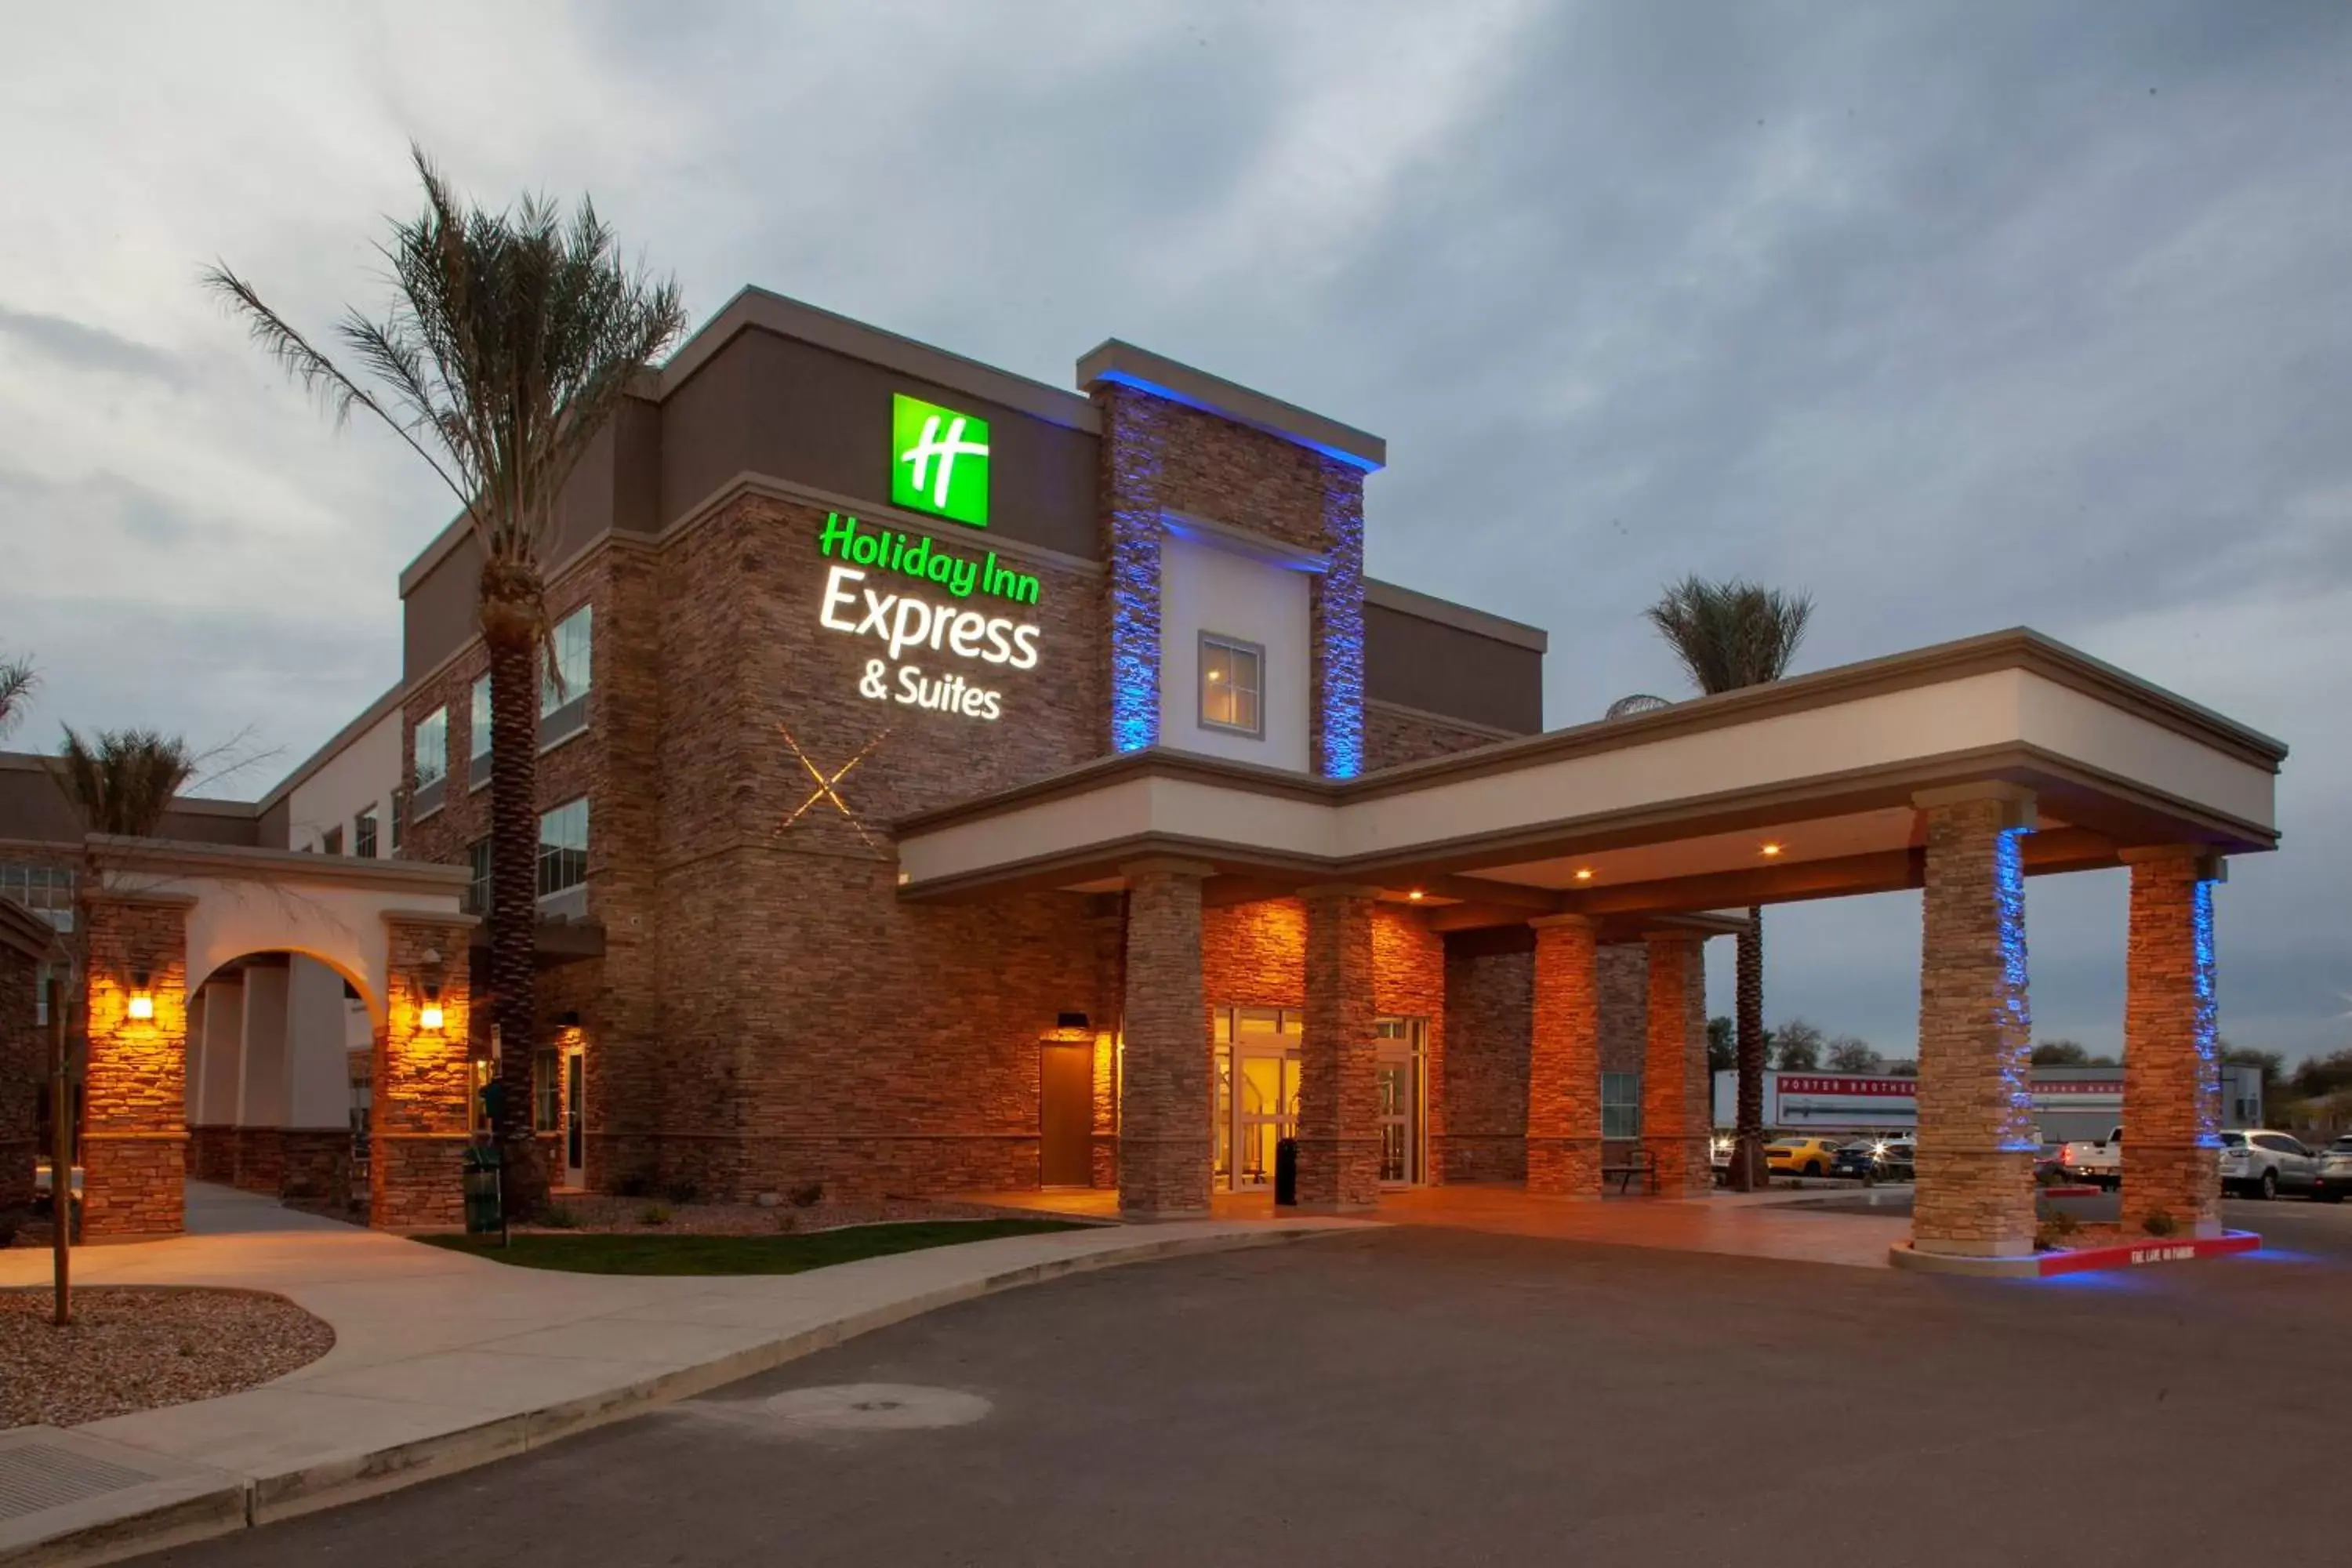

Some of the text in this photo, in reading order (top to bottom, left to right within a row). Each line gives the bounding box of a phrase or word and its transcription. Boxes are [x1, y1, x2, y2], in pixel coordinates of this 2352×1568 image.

[819, 512, 1040, 604] Holiday Inn
[819, 565, 1040, 669] Express
[859, 659, 1002, 720] & Suites
[1782, 1080, 1838, 1091] PORTER
